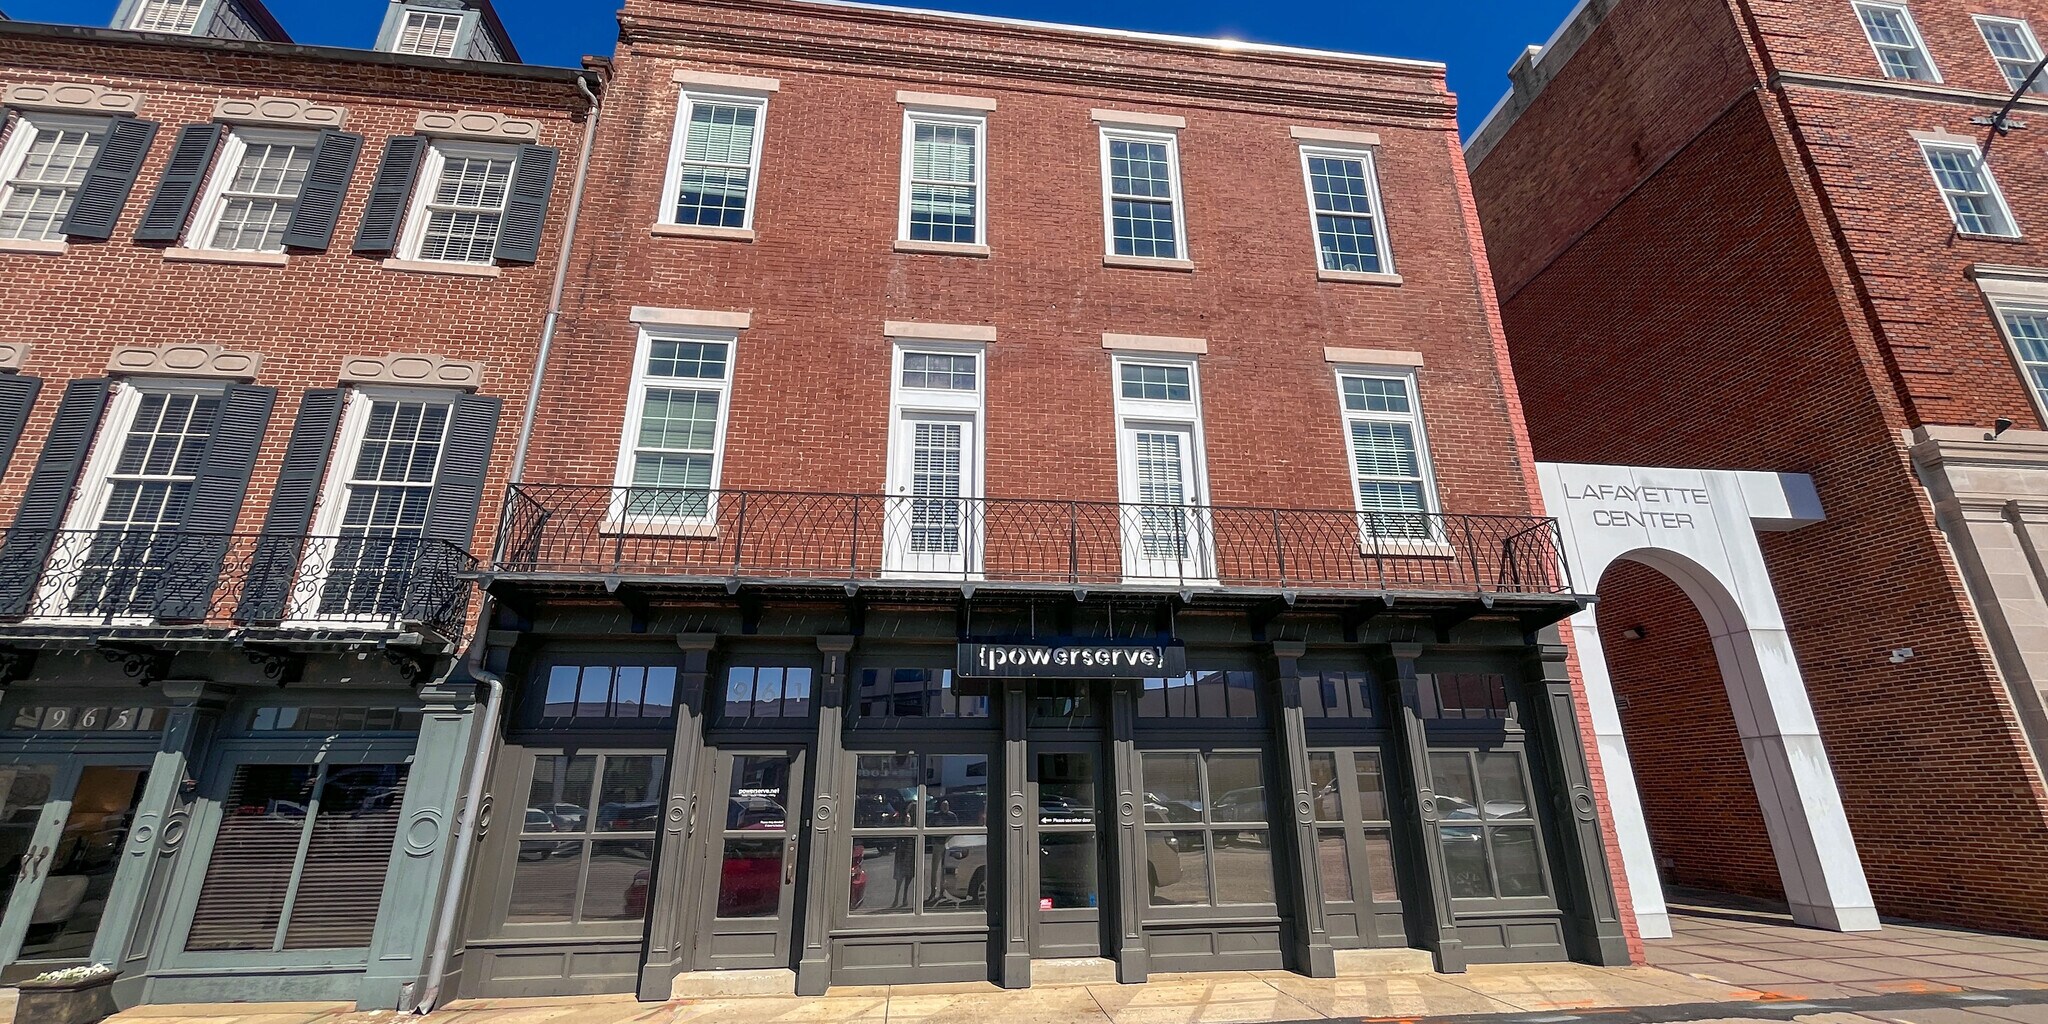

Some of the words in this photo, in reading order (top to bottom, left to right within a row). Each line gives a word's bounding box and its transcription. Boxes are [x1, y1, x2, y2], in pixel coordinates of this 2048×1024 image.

[1563, 483, 1709, 505] LAFAYETTE
[1593, 509, 1695, 529] CENTER
[733, 682, 801, 703] 961
[51, 708, 129, 728] 965
